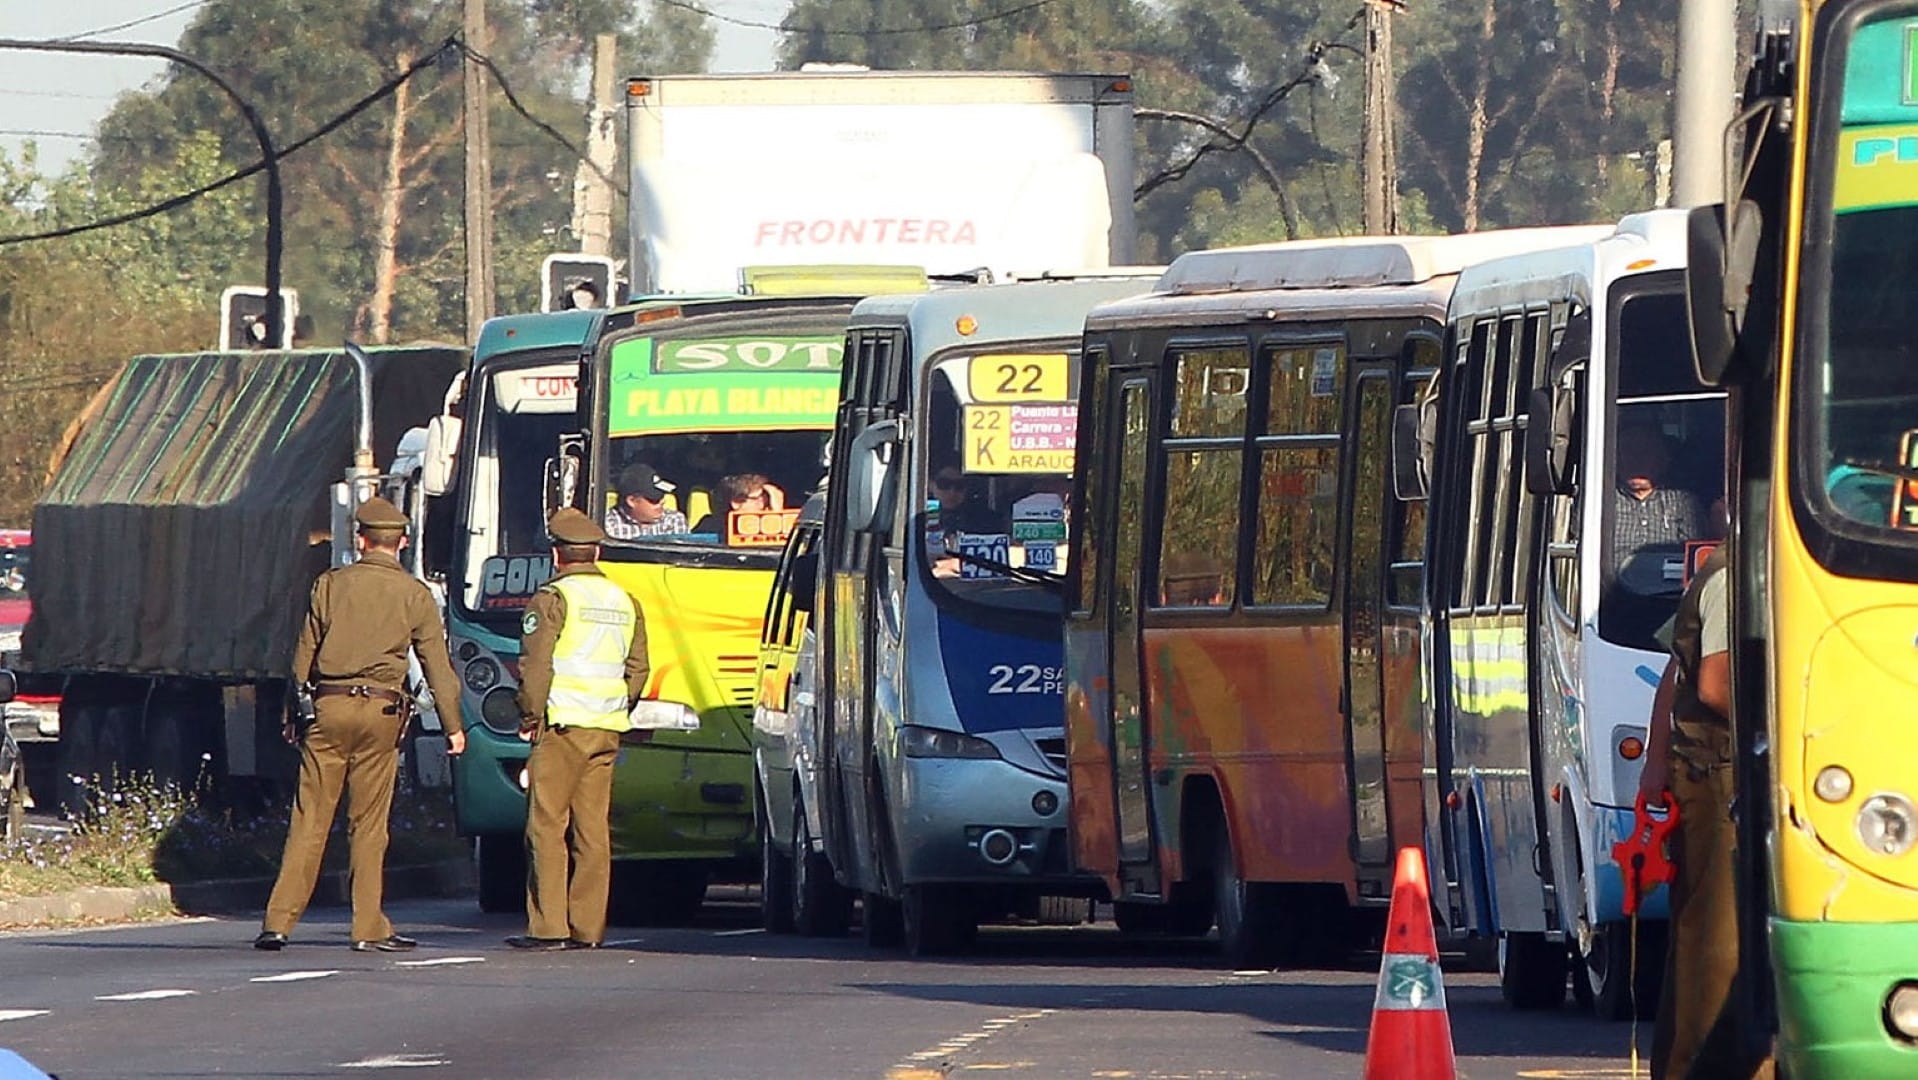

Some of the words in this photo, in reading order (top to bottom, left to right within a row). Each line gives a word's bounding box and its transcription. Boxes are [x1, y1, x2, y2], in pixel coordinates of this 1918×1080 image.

[754, 218, 977, 247] FRONTERA
[996, 364, 1043, 394] 22
[627, 388, 720, 417] PLAYA
[1011, 405, 1059, 418] Puente
[971, 410, 1001, 430] 22
[1011, 420, 1063, 434] Carrera
[976, 437, 995, 467] K
[1028, 549, 1053, 564] 140
[484, 557, 556, 595] CON
[988, 665, 1041, 694] 22
